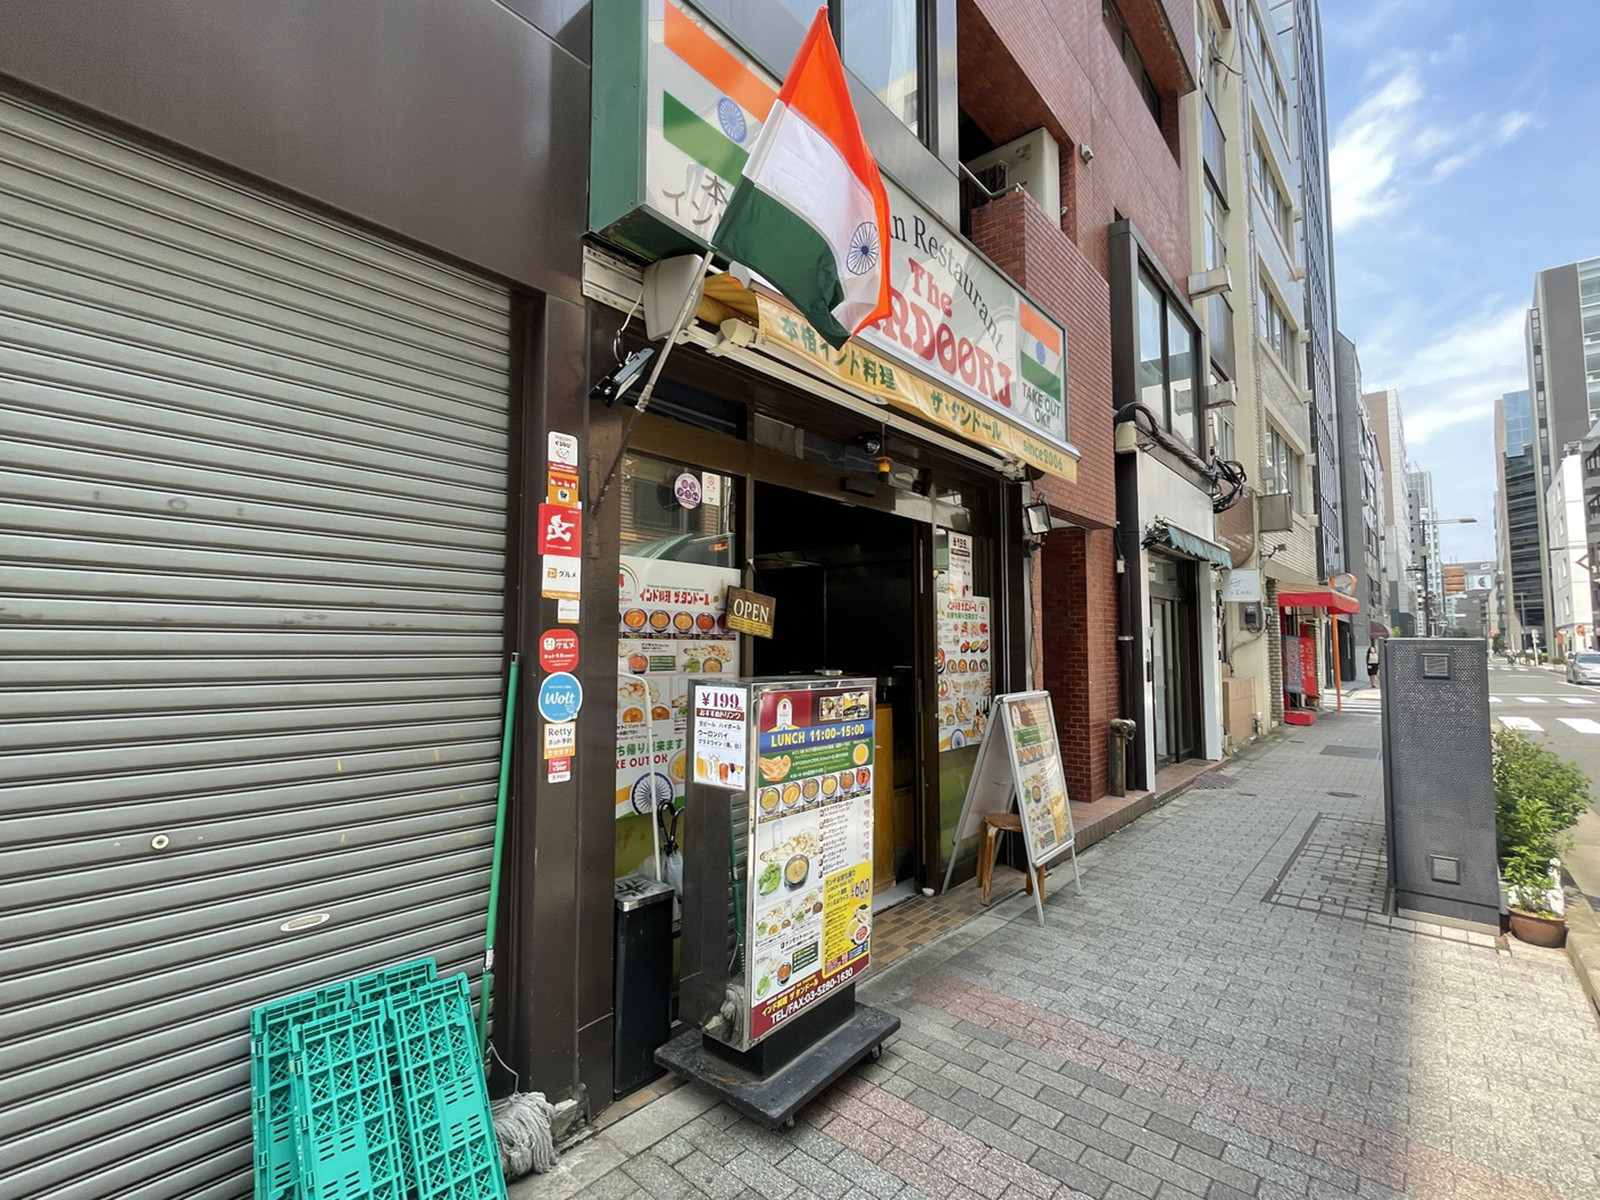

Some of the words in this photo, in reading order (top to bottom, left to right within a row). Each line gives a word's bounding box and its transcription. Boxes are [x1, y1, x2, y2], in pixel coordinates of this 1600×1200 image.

[701, 174, 729, 207] 本
[662, 188, 722, 226] イン
[890, 214, 908, 243] n
[913, 214, 1004, 354] Restaurant
[908, 257, 953, 318] The
[868, 285, 1012, 409] NDOORI
[1022, 382, 1044, 409] TAKE
[1044, 398, 1061, 420] OUT
[558, 570, 577, 578] グルメ
[733, 598, 770, 623] OPEN
[545, 691, 576, 705] Wolt
[702, 691, 740, 709] ¥199
[548, 728, 573, 737] Retty
[770, 731, 806, 748] LUNCH
[809, 723, 865, 742] 11:00-15:00
[629, 755, 650, 767] OUT
[653, 753, 668, 764] OK
